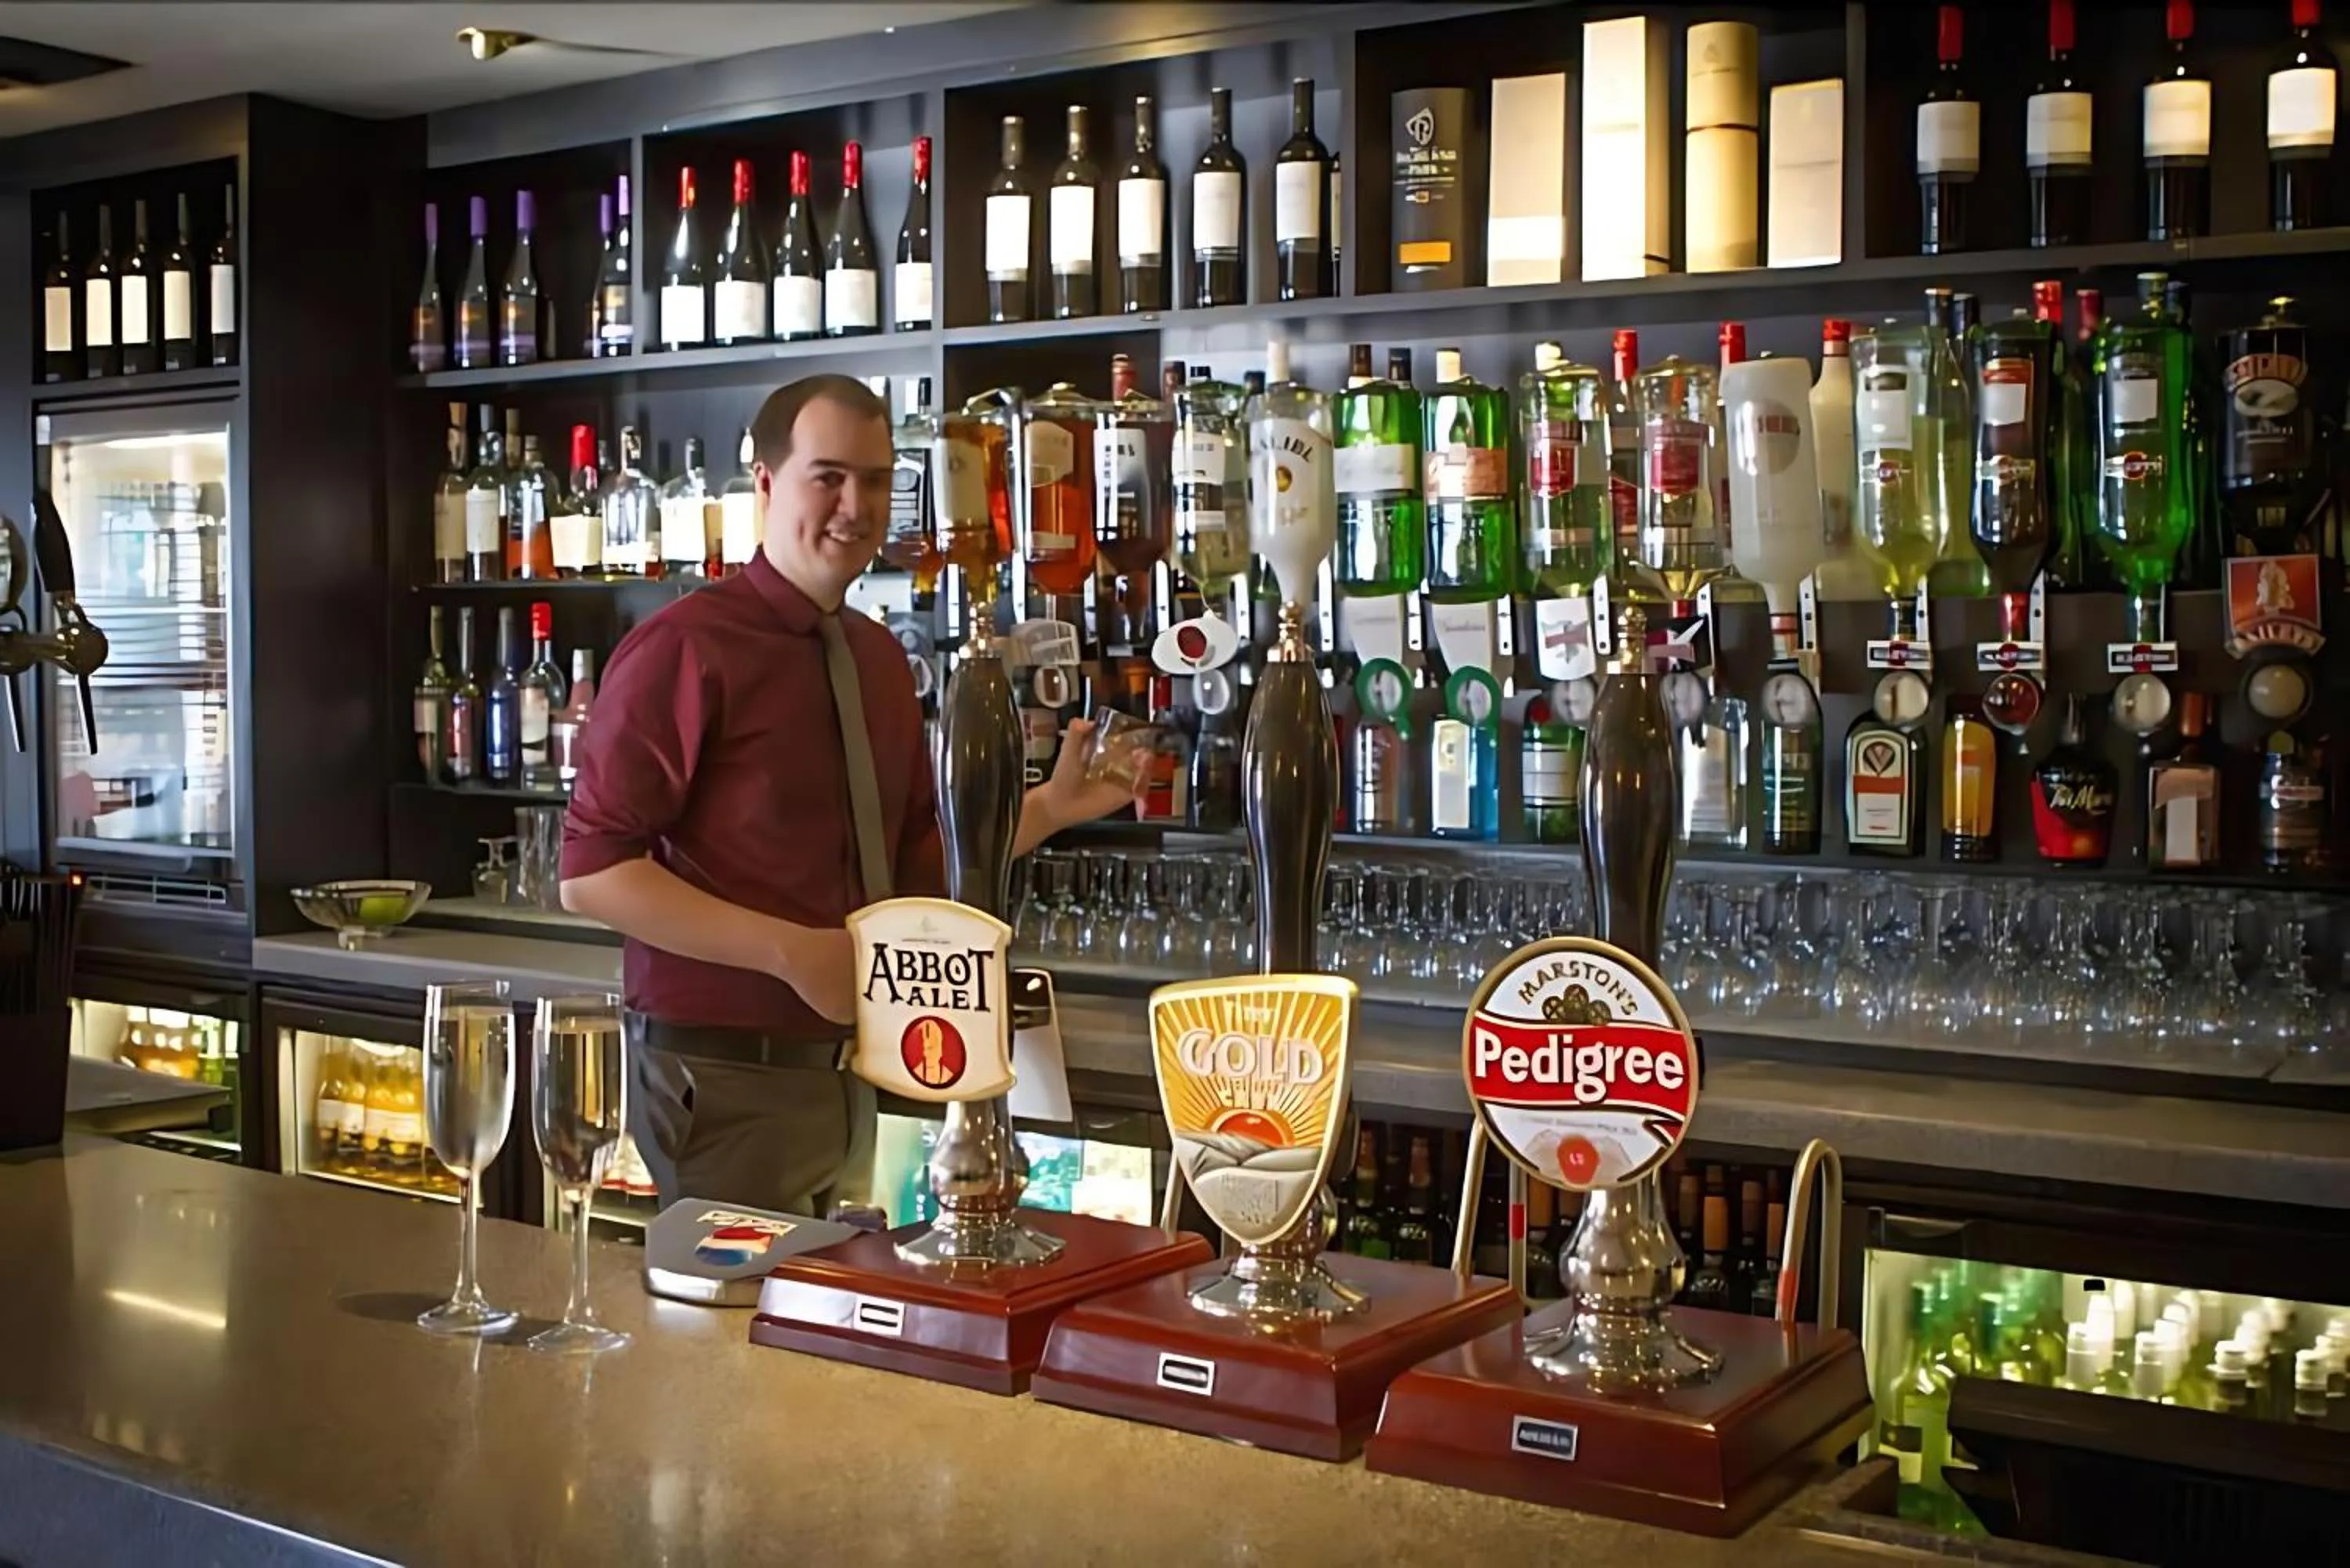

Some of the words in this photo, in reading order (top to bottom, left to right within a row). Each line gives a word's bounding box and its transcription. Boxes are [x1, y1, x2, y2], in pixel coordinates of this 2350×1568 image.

[862, 942, 995, 1013] ABBOT
[906, 986, 970, 1010] ALE
[1517, 960, 1638, 1016] MARSTON'S
[1177, 1027, 1324, 1085] GOLD
[1474, 1027, 1684, 1103] Pedigree
